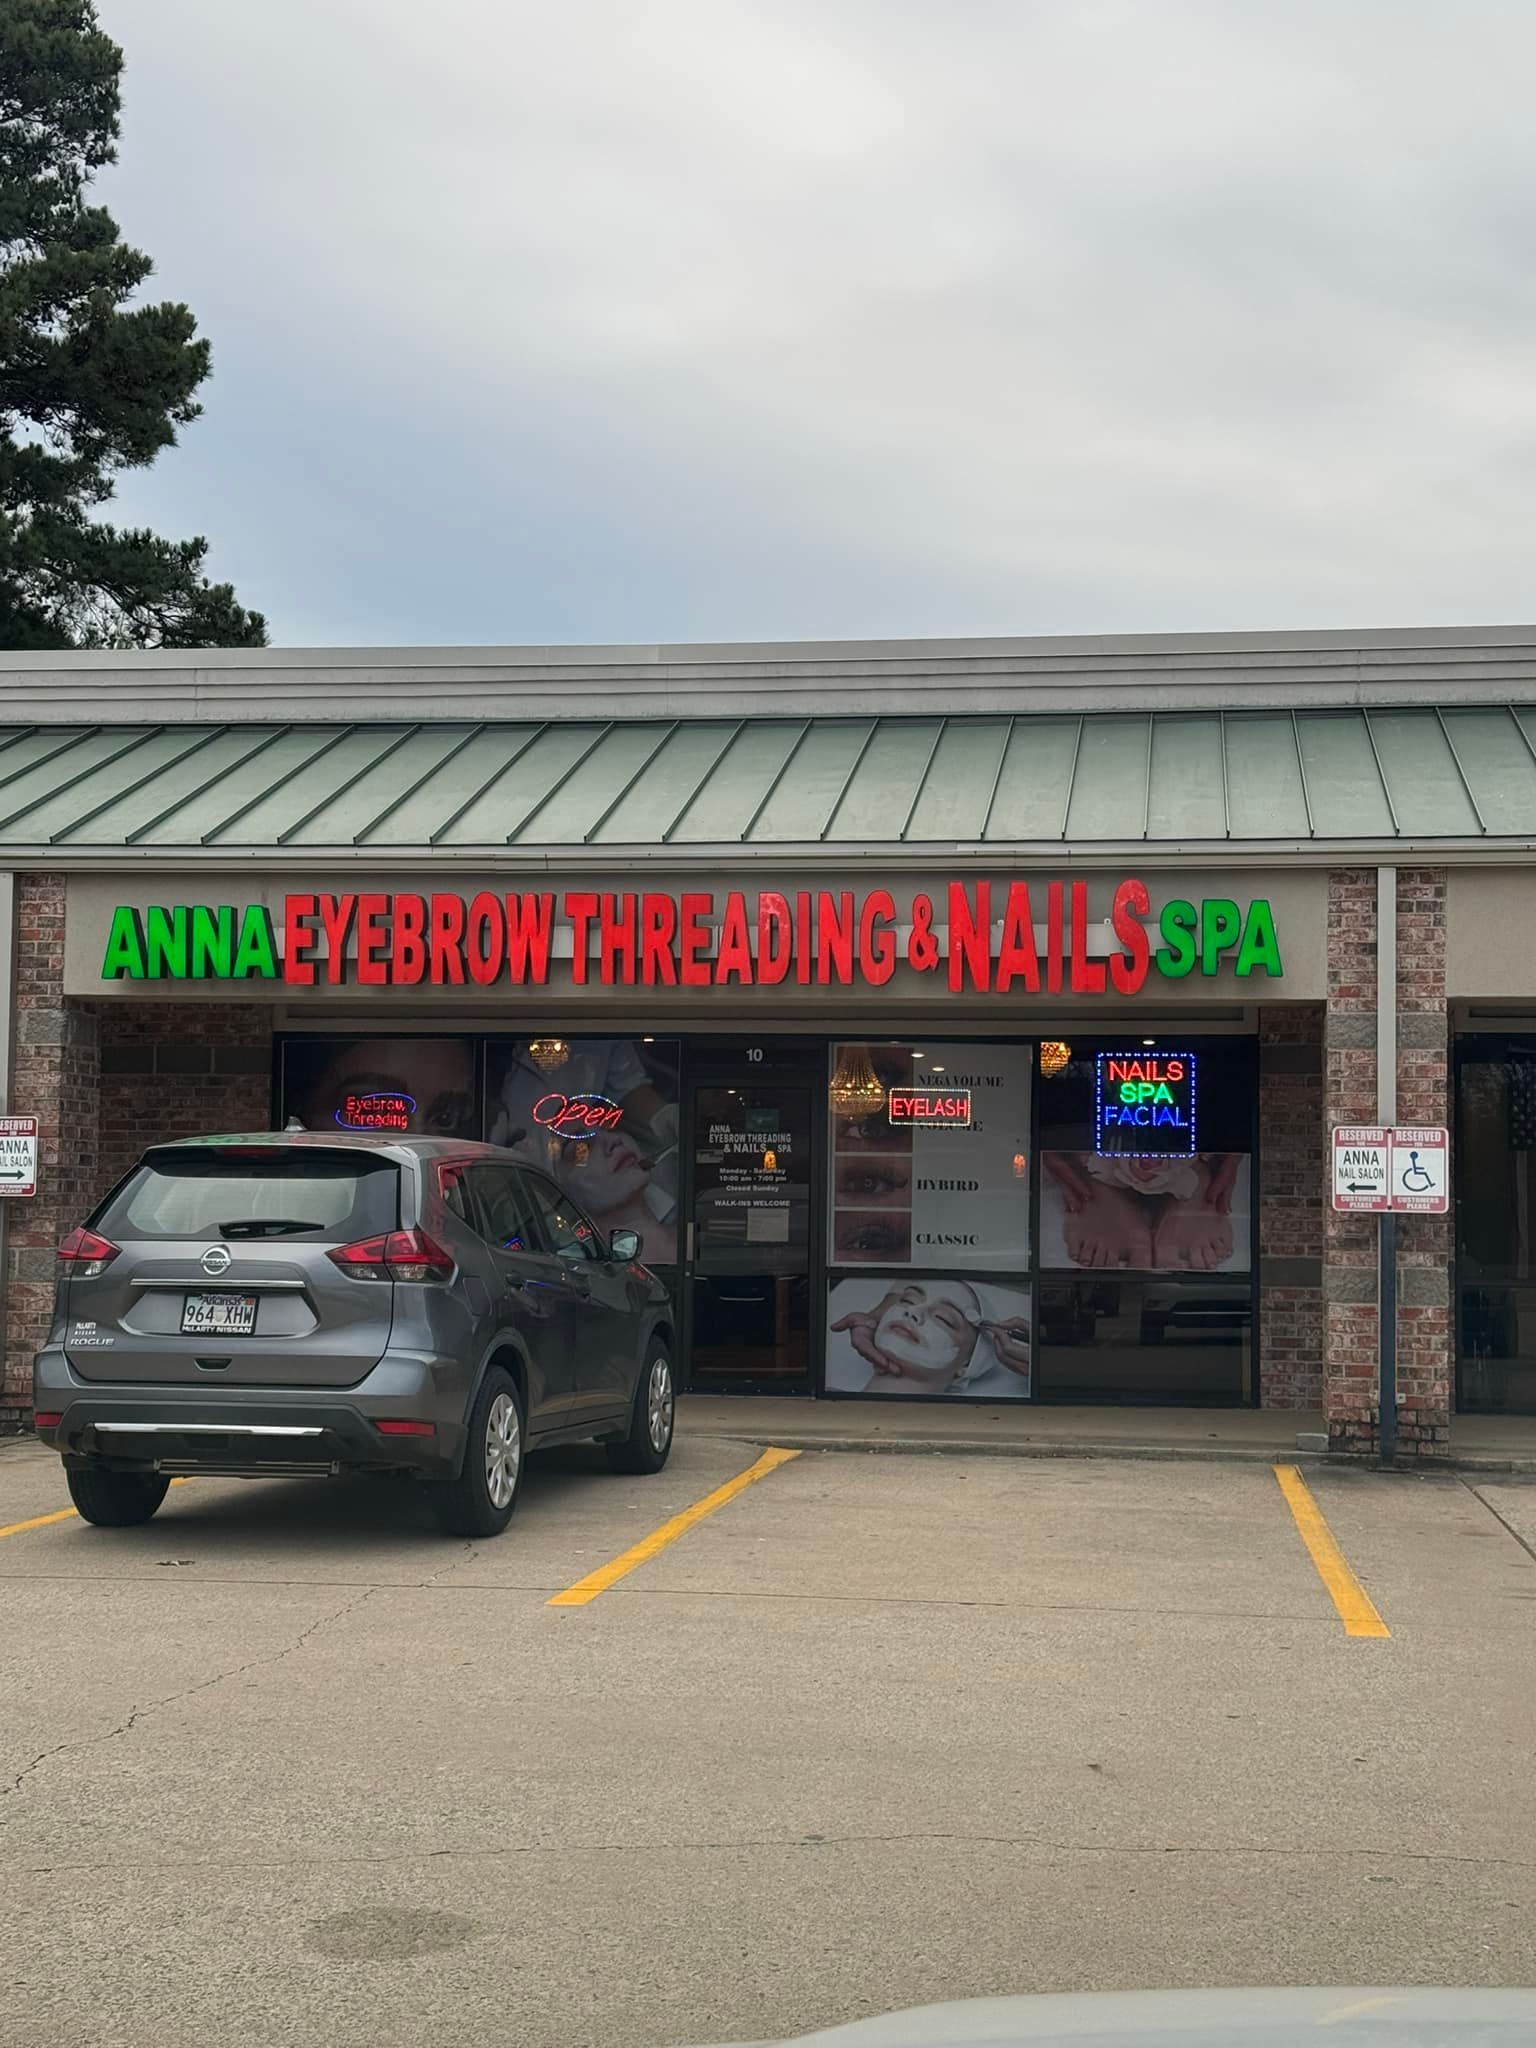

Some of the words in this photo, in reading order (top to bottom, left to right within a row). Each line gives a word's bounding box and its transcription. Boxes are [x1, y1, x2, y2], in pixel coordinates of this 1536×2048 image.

[101, 905, 281, 980] ANNA
[284, 892, 552, 986] EYEBROW
[565, 889, 898, 986] THREADING
[907, 893, 941, 972] &
[947, 878, 1151, 995] NAILS
[1155, 899, 1284, 979] SPA
[746, 1048, 763, 1062] 10
[1109, 1061, 1184, 1081] NAILS
[953, 1075, 1004, 1088] VOLUME
[1119, 1082, 1174, 1104] SPA
[532, 1093, 624, 1129] Open
[892, 1098, 968, 1117] EYELASH
[346, 1112, 408, 1130] Threading
[1104, 1106, 1189, 1126] FACIAL
[0, 1120, 33, 1130] ESERVED
[709, 1125, 730, 1133] ANNA
[709, 1134, 746, 1143] EYEBROW
[747, 1134, 792, 1143] THREADING
[1339, 1130, 1384, 1141] RESERVED
[1396, 1131, 1441, 1142] RESERVED
[723, 1143, 731, 1153] &
[733, 1143, 767, 1153] NAILS
[777, 1144, 792, 1153] SPA
[10, 1156, 33, 1168] SALON
[1343, 1150, 1379, 1165] ANNA
[1338, 1168, 1356, 1179] NAIL
[1358, 1168, 1384, 1179] SALON
[753, 1185, 779, 1193] Sunday
[917, 1179, 979, 1192] HYBIRD
[916, 1233, 979, 1246] CLASSIC
[186, 1305, 214, 1323] 964
[224, 1306, 253, 1325] XHW
[70, 1338, 115, 1346] ROGUE
